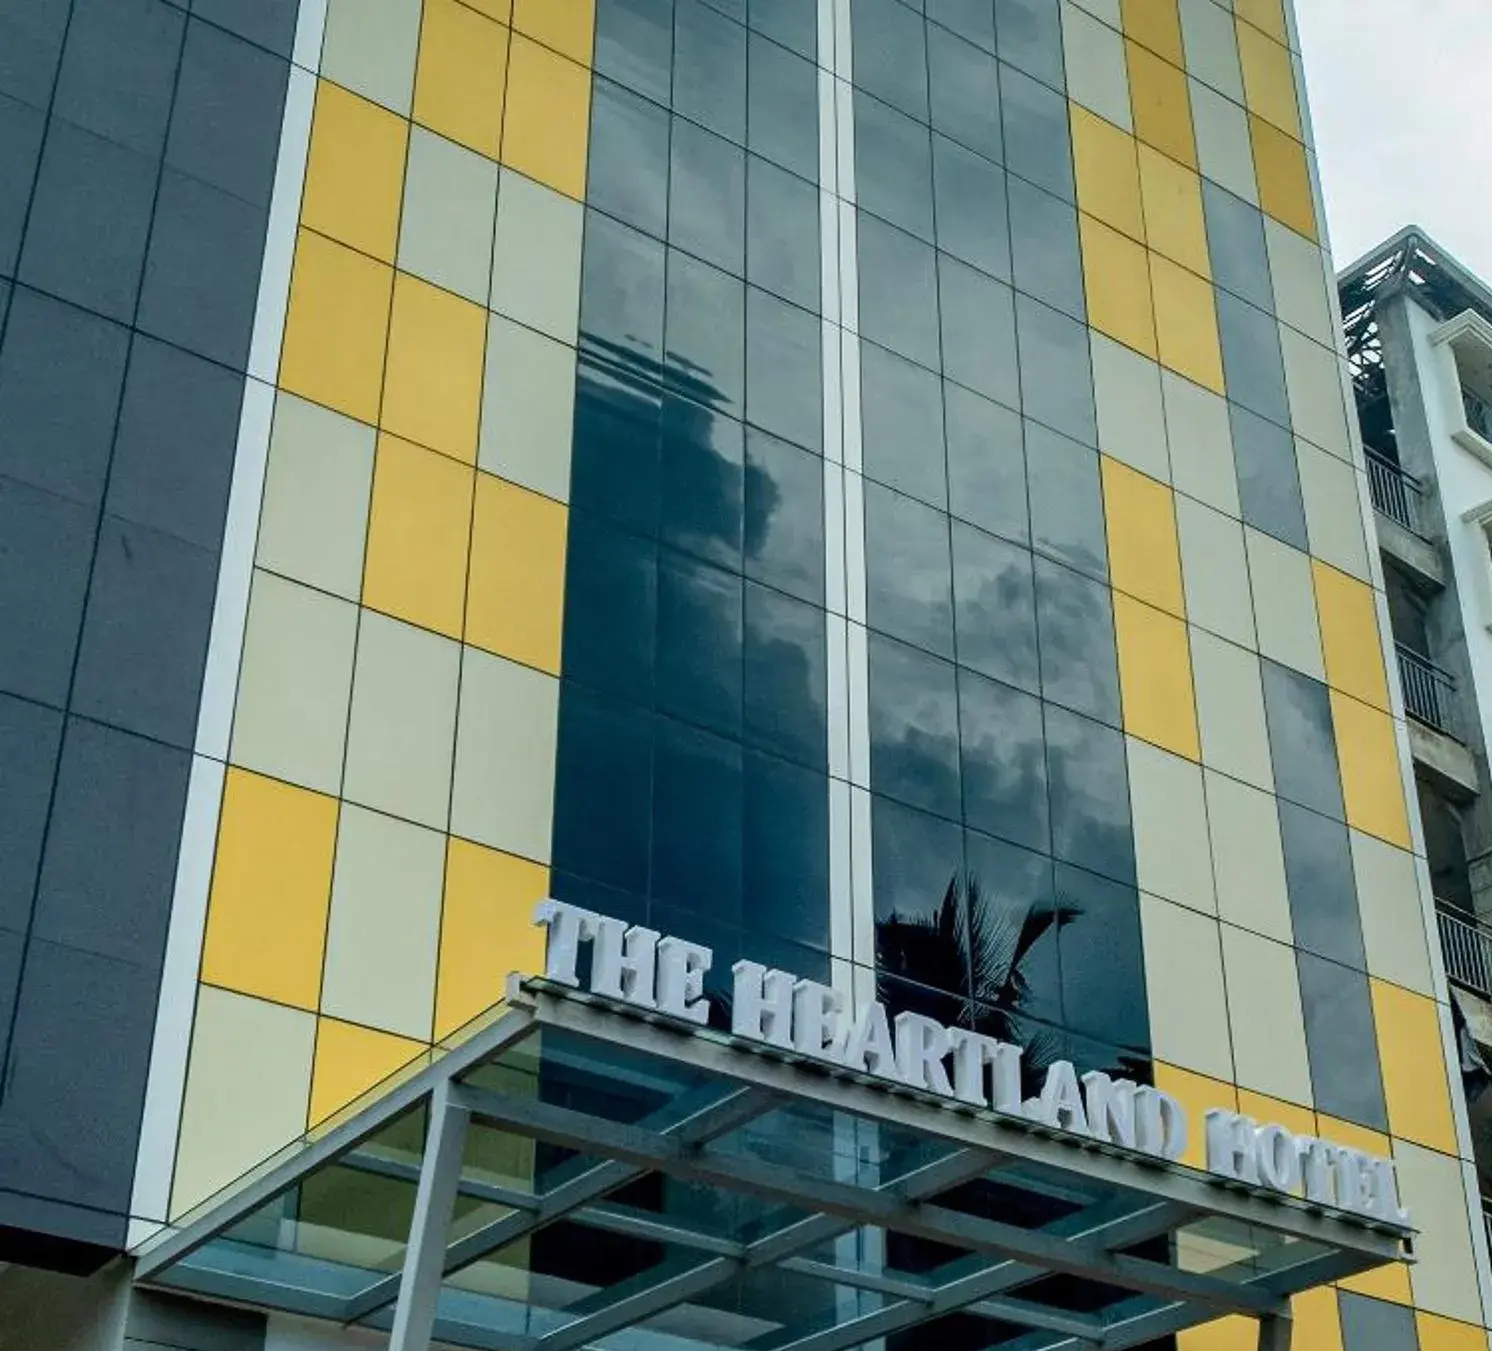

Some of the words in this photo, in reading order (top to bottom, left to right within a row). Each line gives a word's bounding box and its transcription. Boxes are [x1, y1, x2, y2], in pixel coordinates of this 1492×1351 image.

[532, 897, 713, 1026] THE
[731, 958, 1189, 1163] HEARTLAND
[1204, 1107, 1411, 1229] HOTEL
